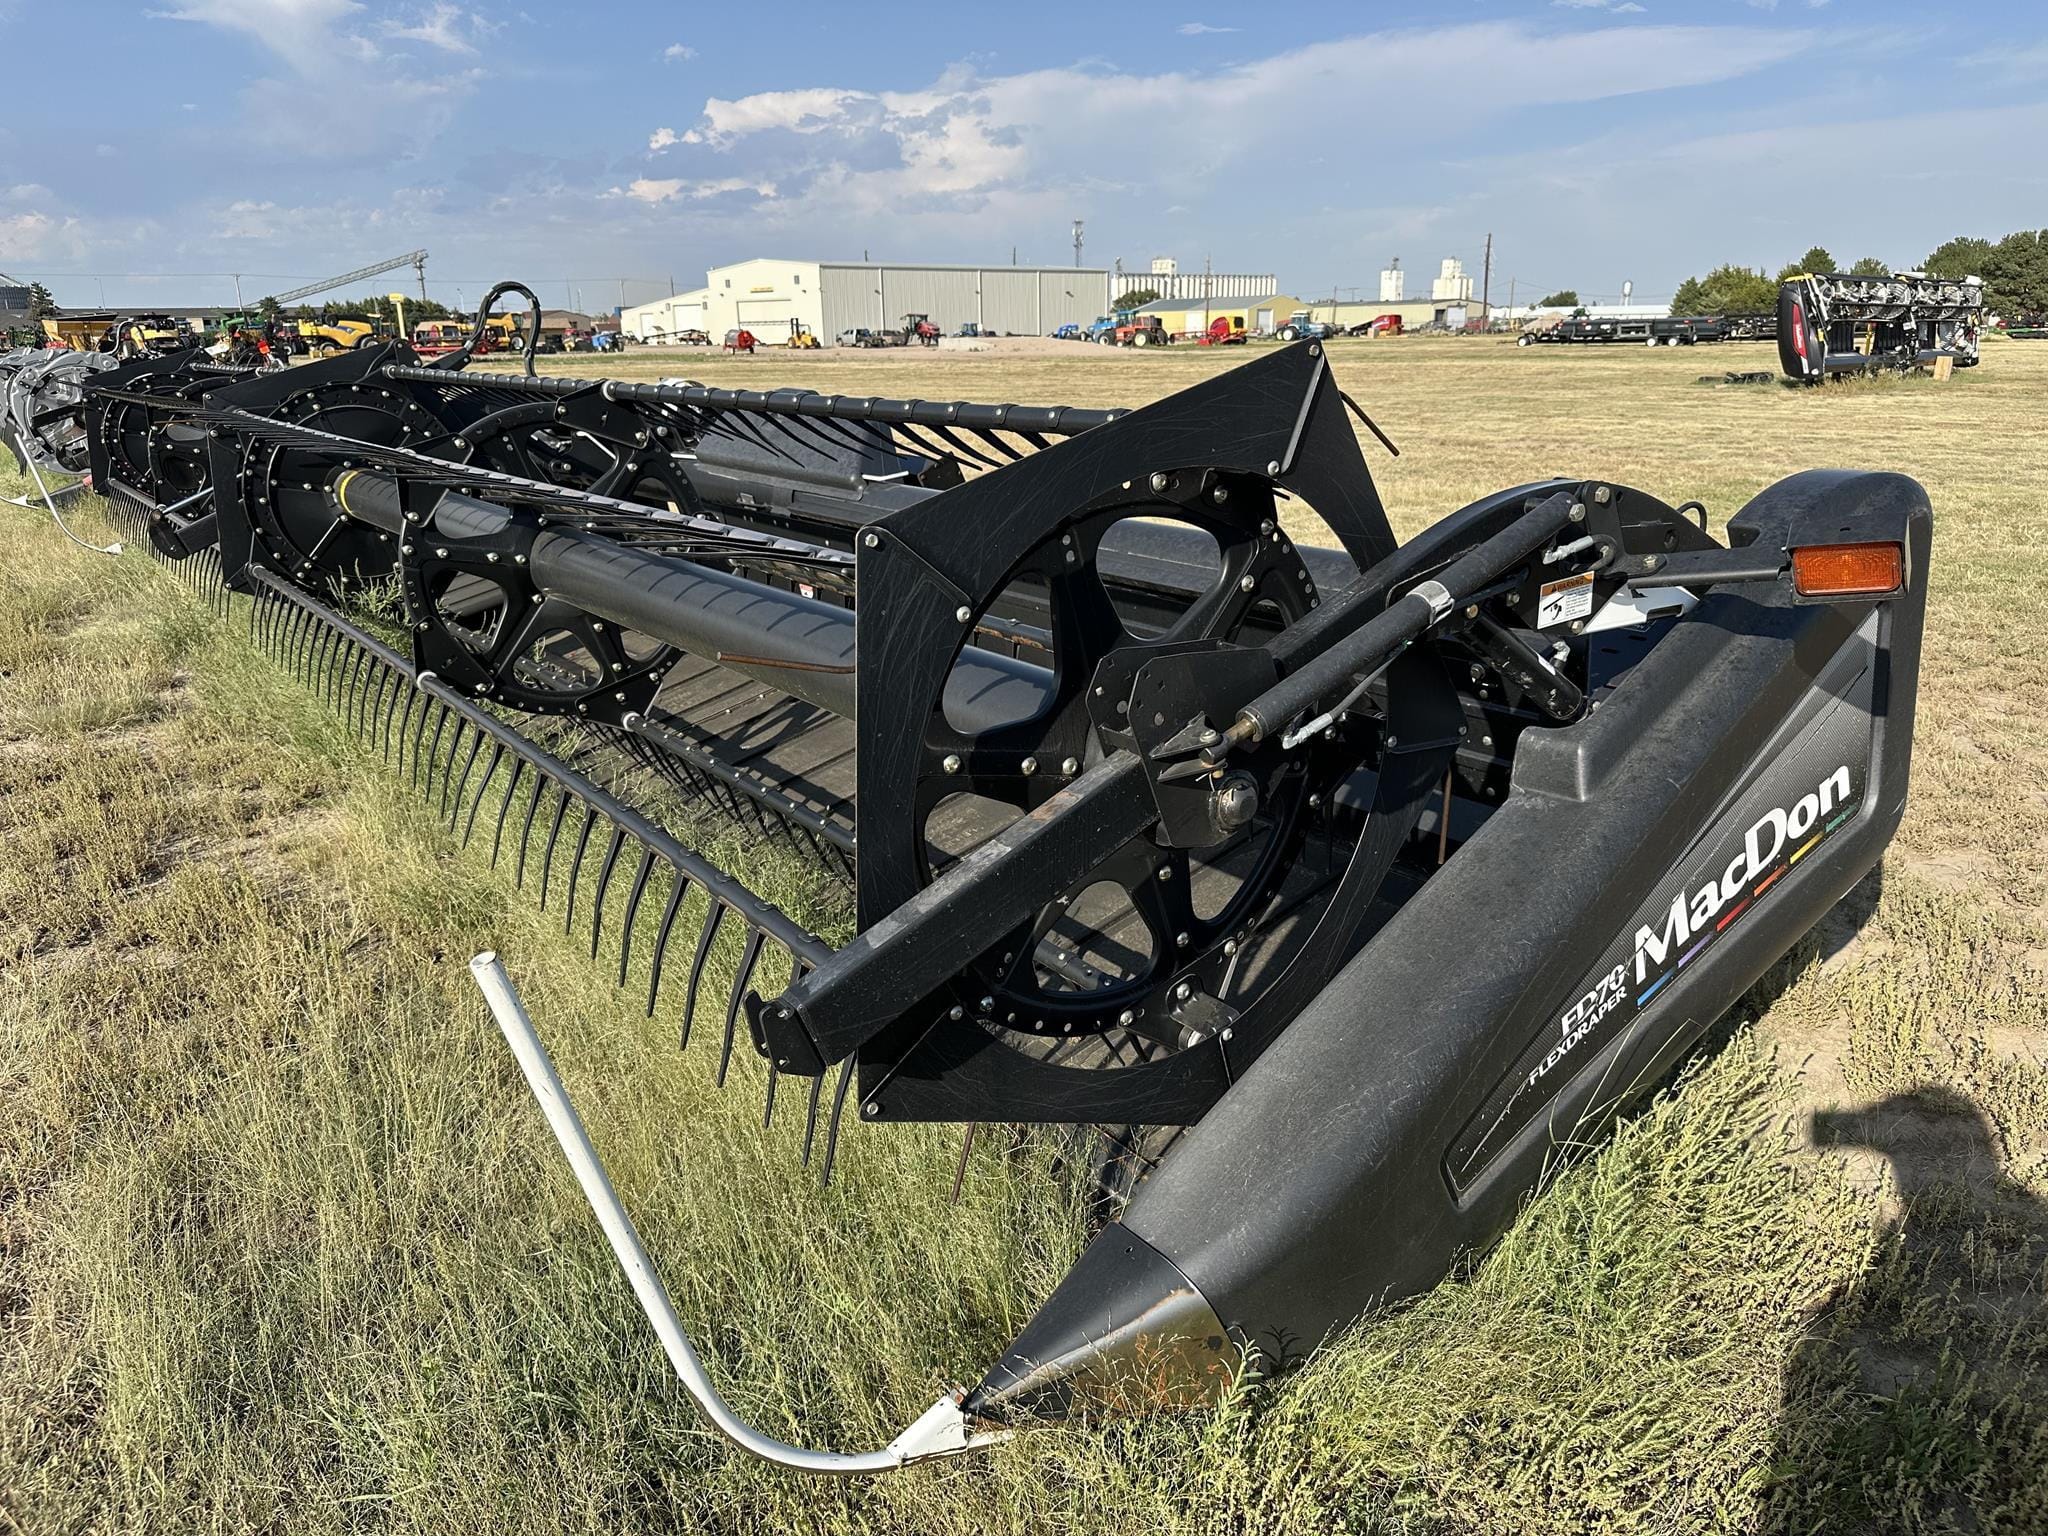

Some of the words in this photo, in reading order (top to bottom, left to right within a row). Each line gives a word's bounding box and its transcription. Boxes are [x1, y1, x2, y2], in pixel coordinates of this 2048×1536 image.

[1635, 765, 1850, 985] MacDon
[1529, 986, 1627, 1086] FLEXDRAPER
[1561, 964, 1625, 1036] FD70
